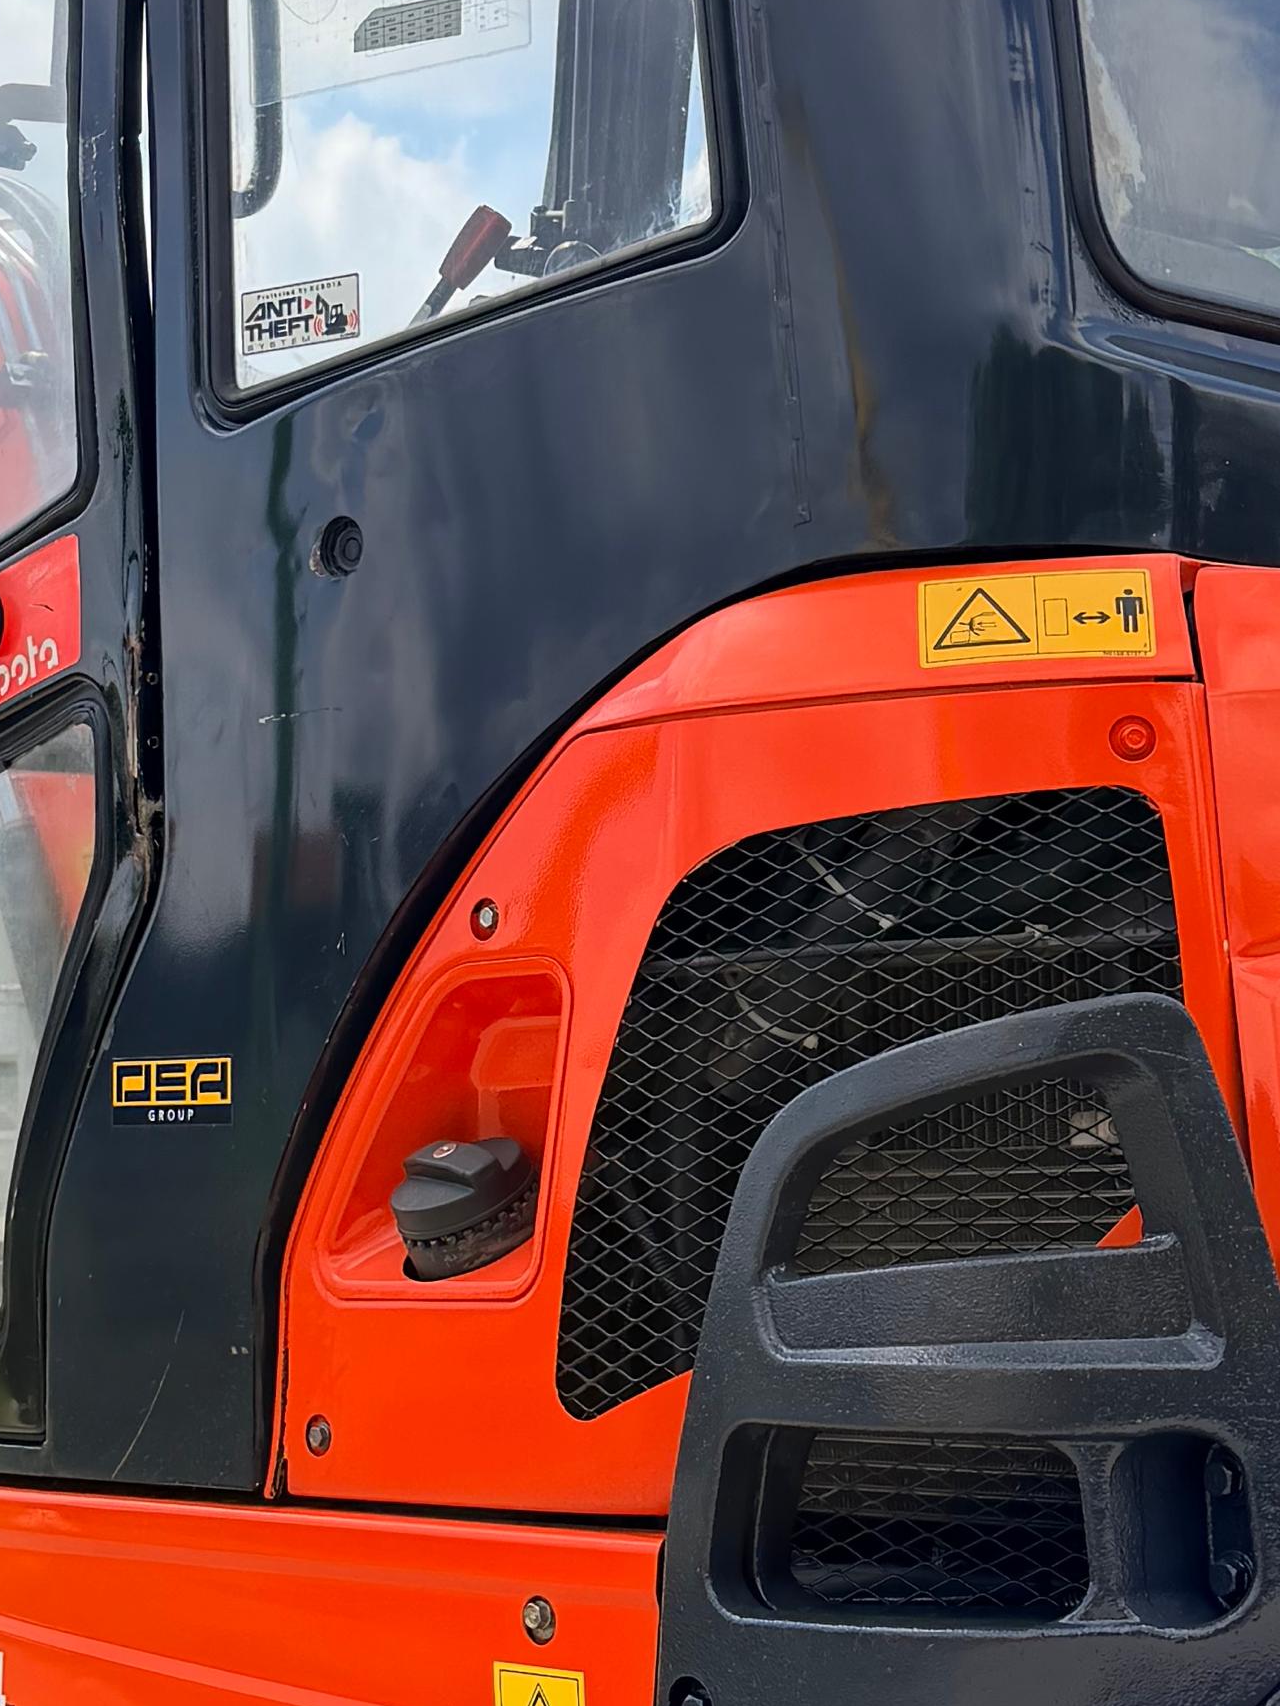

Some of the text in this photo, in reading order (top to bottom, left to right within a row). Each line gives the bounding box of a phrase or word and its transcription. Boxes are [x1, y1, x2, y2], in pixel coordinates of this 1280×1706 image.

[245, 296, 302, 323] ANTI
[244, 314, 315, 342] THEFT
[247, 336, 310, 352] SYSTEM
[147, 1108, 195, 1122] GROUP
